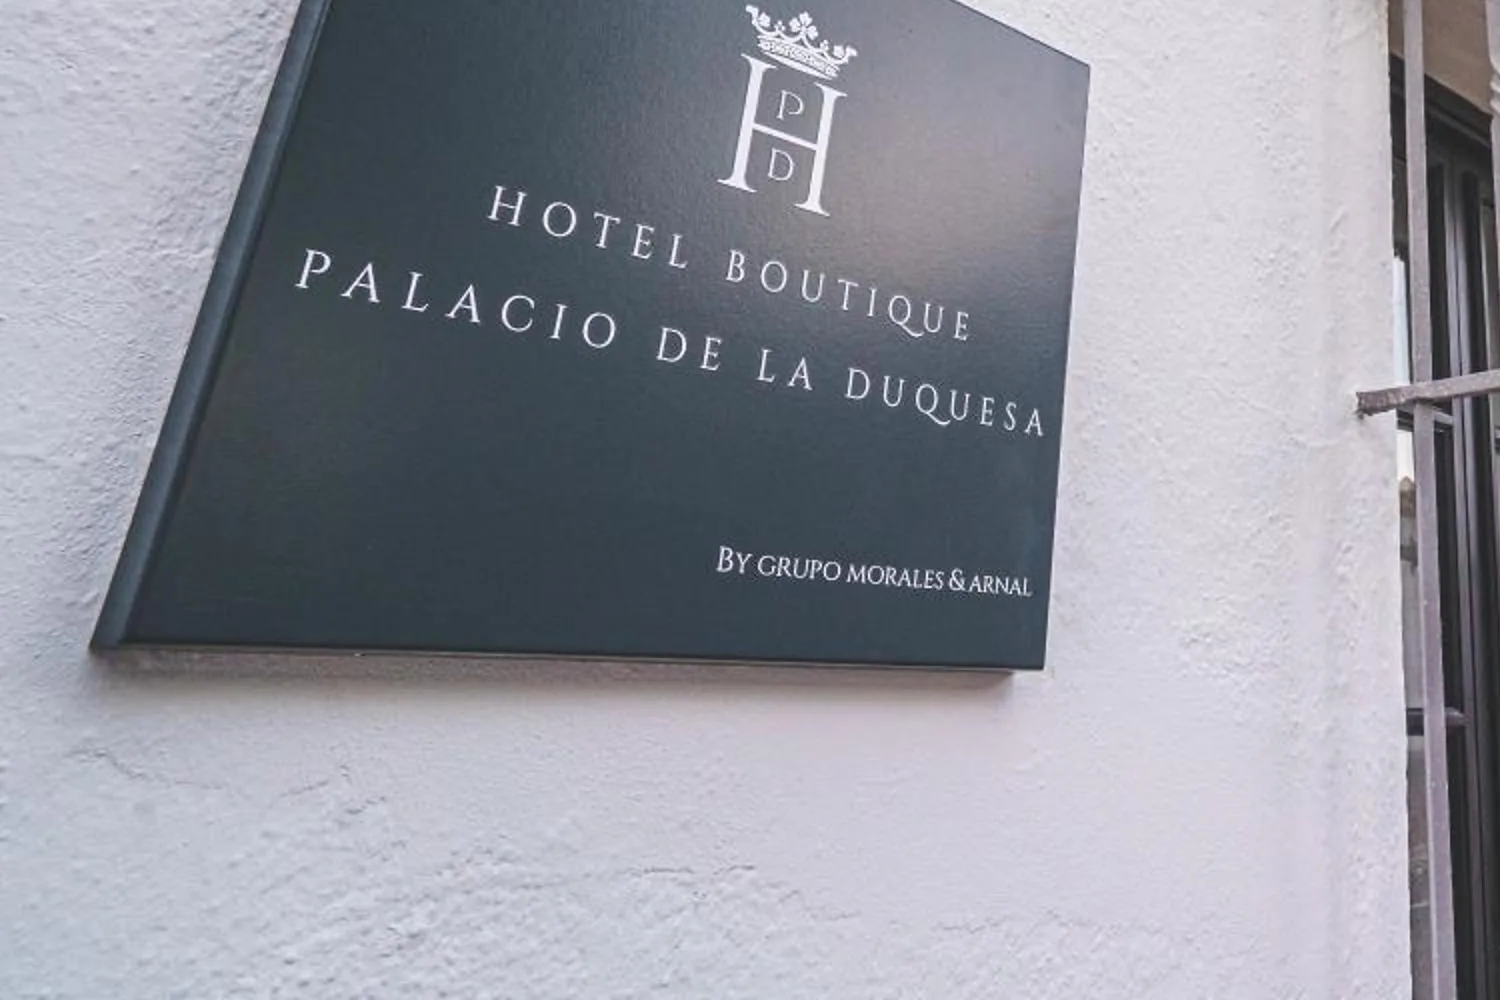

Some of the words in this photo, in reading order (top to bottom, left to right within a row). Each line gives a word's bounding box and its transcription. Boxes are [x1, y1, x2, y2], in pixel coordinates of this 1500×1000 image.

[293, 247, 619, 350] PALACIO
[655, 325, 724, 372] DE
[756, 346, 814, 392] LA
[843, 366, 1047, 439] DUQUESA
[486, 184, 690, 270] HOTEL
[724, 247, 972, 343] BOUTIQUE
[756, 554, 842, 582] GRUPO
[845, 563, 946, 592] MORALES
